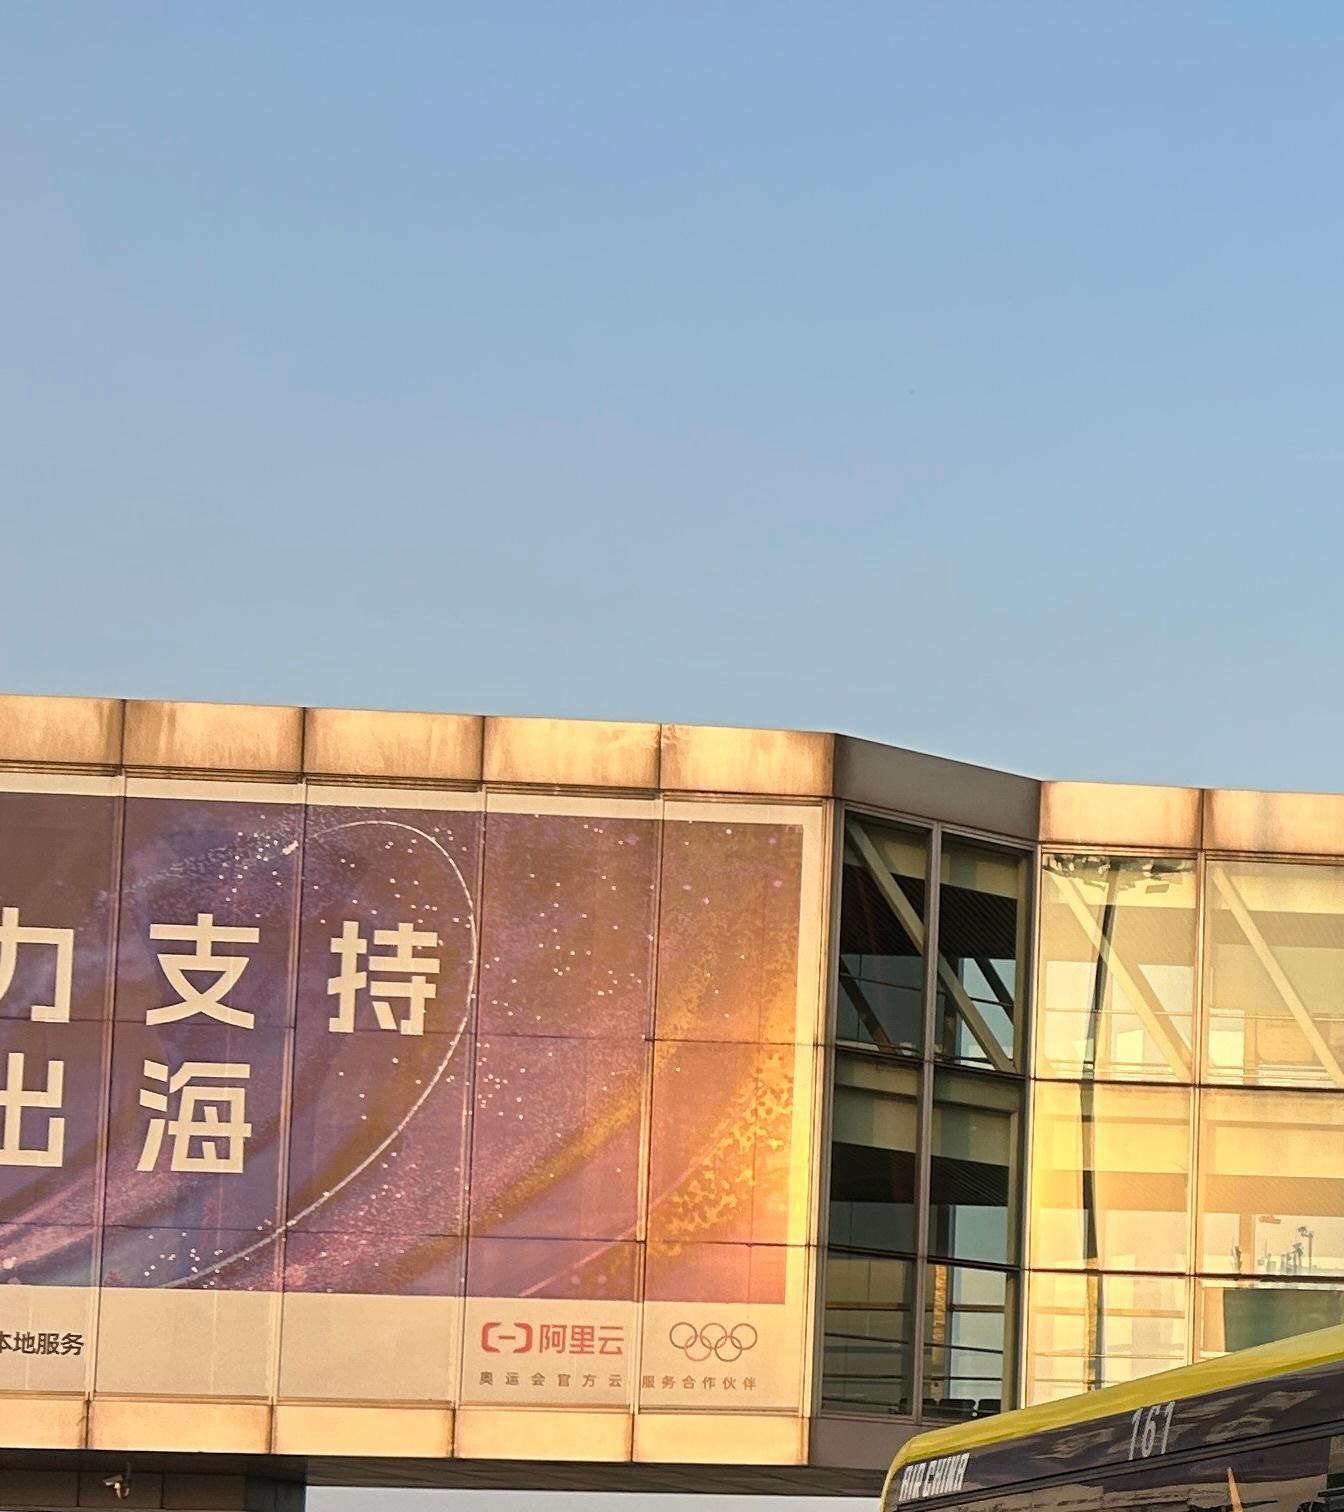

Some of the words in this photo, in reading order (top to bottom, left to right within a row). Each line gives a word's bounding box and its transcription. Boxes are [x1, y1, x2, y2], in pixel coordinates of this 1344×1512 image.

[0, 907, 441, 1036] 力支持
[0, 1053, 252, 1173] 出海
[539, 1324, 625, 1355] 阿里云
[1128, 1401, 1176, 1461] 161
